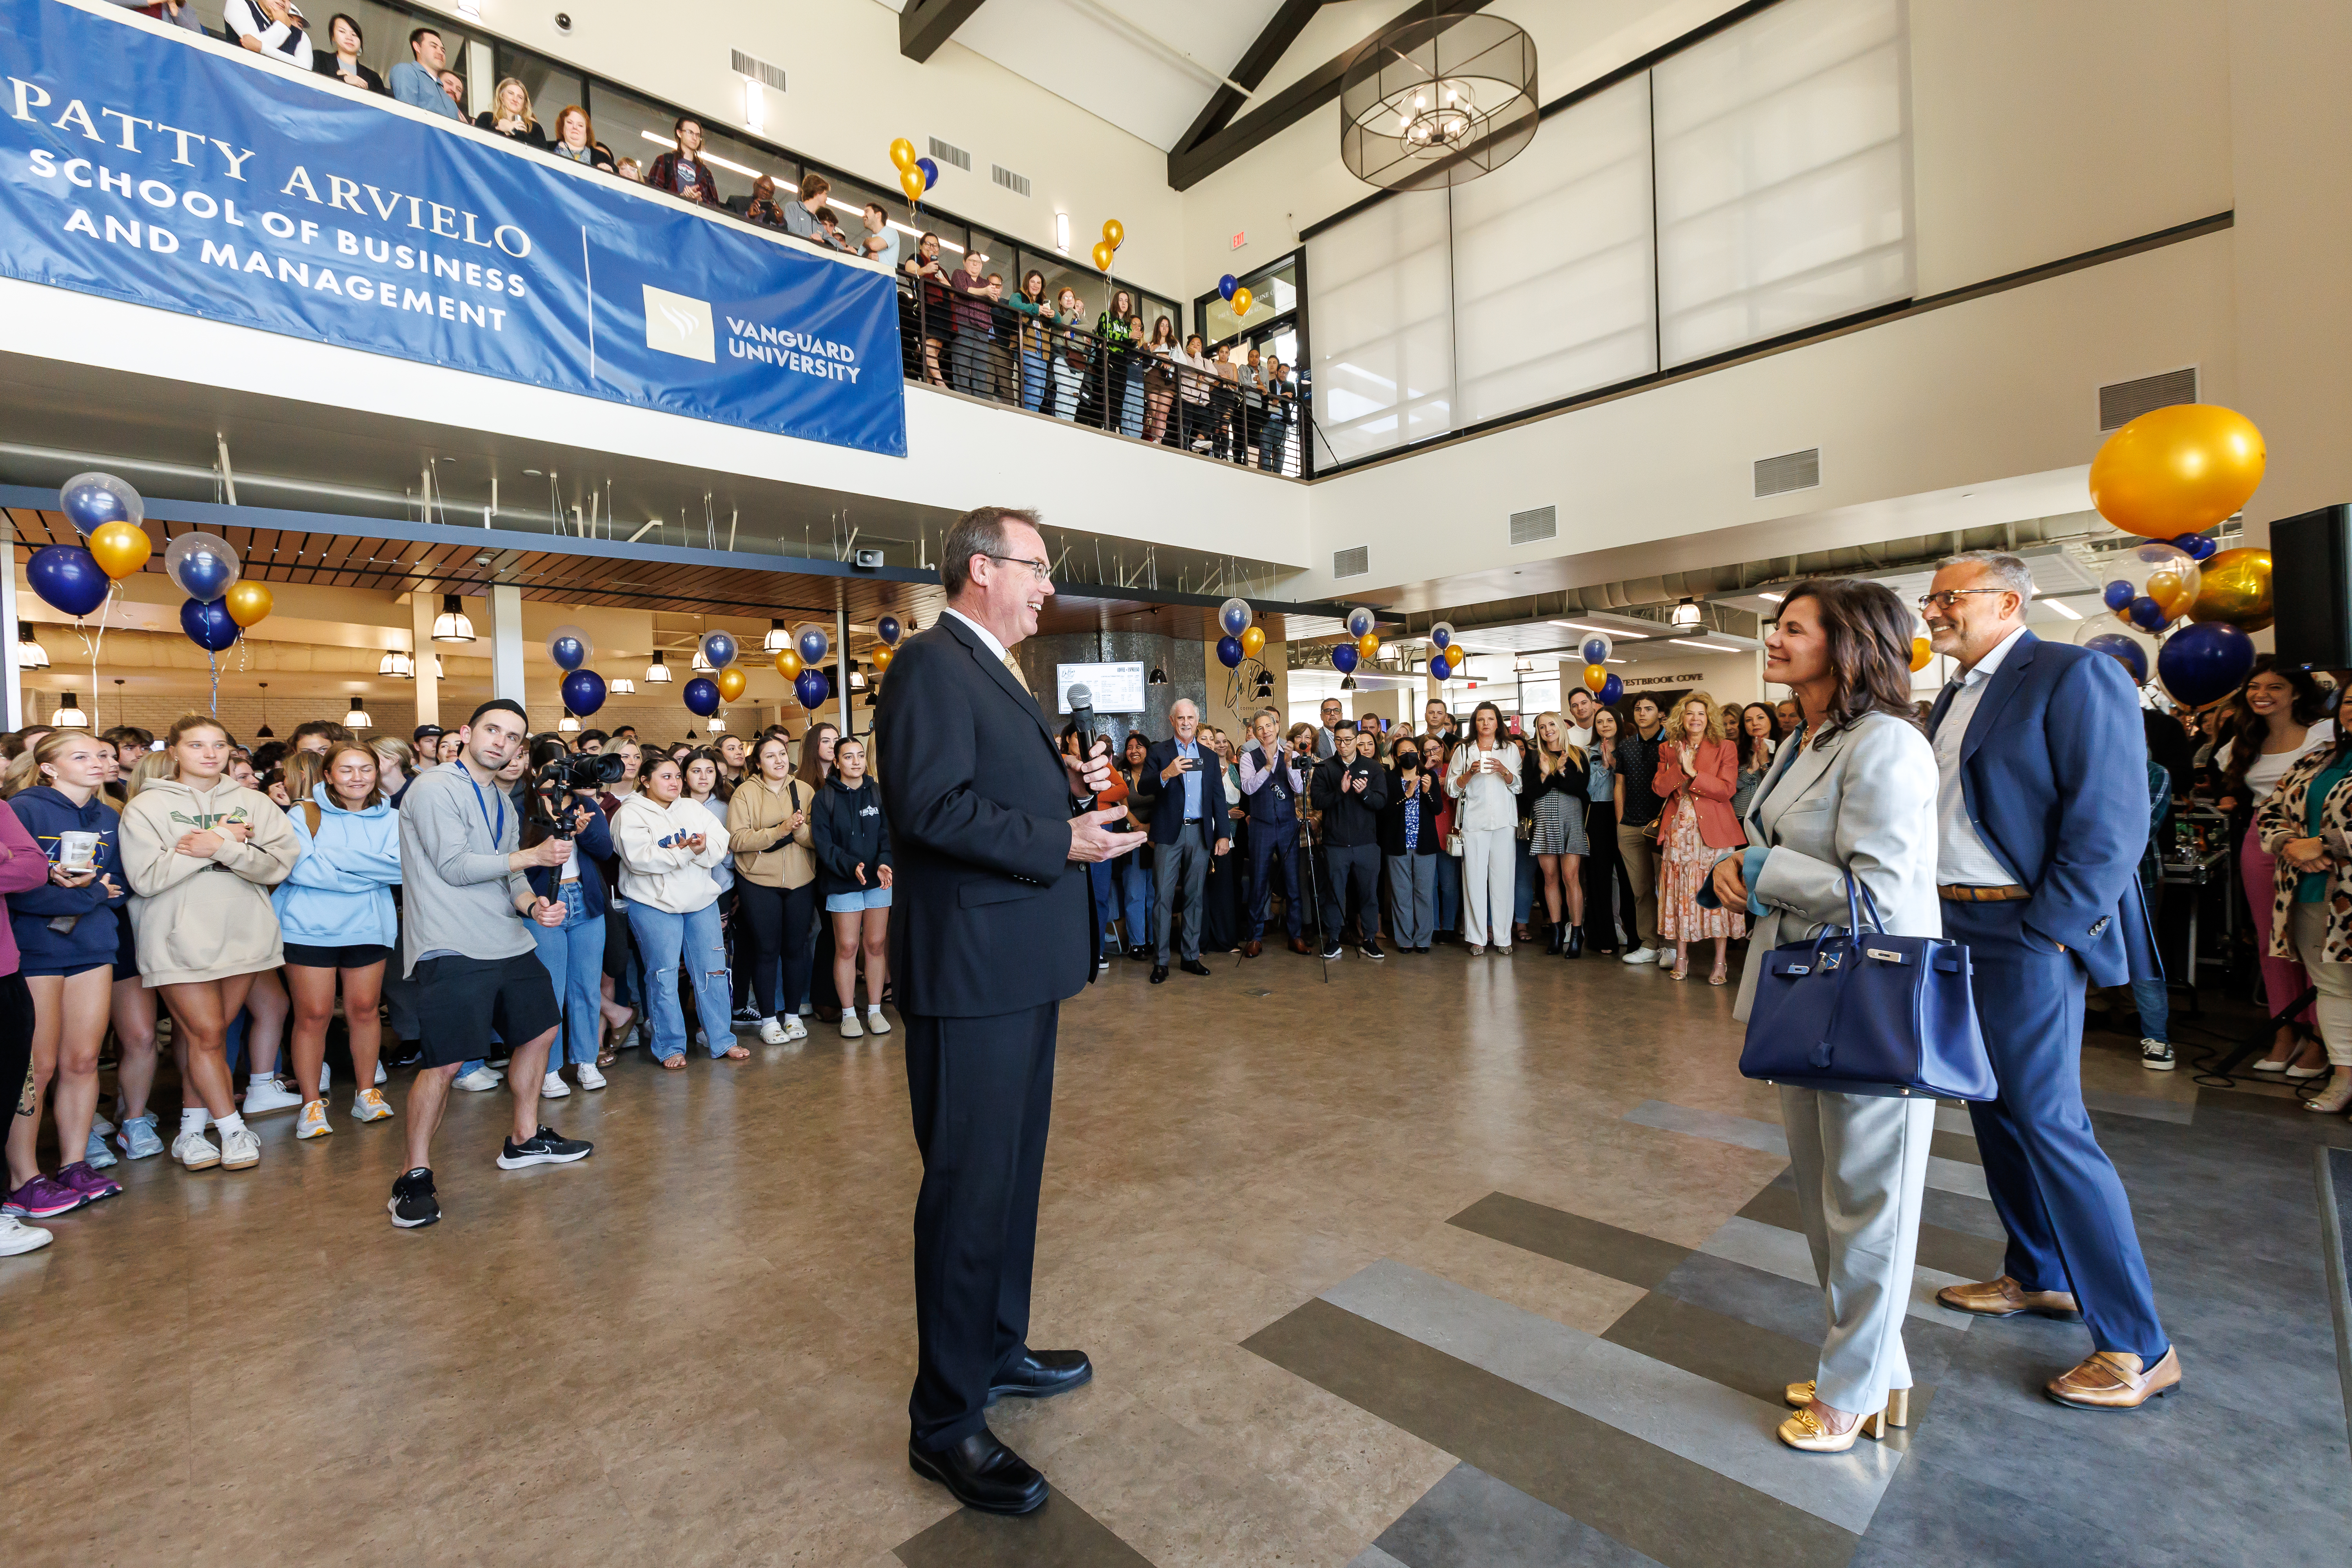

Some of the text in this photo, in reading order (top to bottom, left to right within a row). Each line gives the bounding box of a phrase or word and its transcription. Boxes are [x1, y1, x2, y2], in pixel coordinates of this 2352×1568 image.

[7, 76, 532, 258] PATTY ARVIELO
[28, 149, 525, 297] SCHOOL OF BUSINESS
[1233, 231, 1244, 248] EXIT
[63, 209, 506, 331] AND MANAGEMENT
[726, 316, 855, 362] VANGUARD
[729, 337, 860, 384] UNIVERSITY
[1676, 673, 1704, 682] COVE
